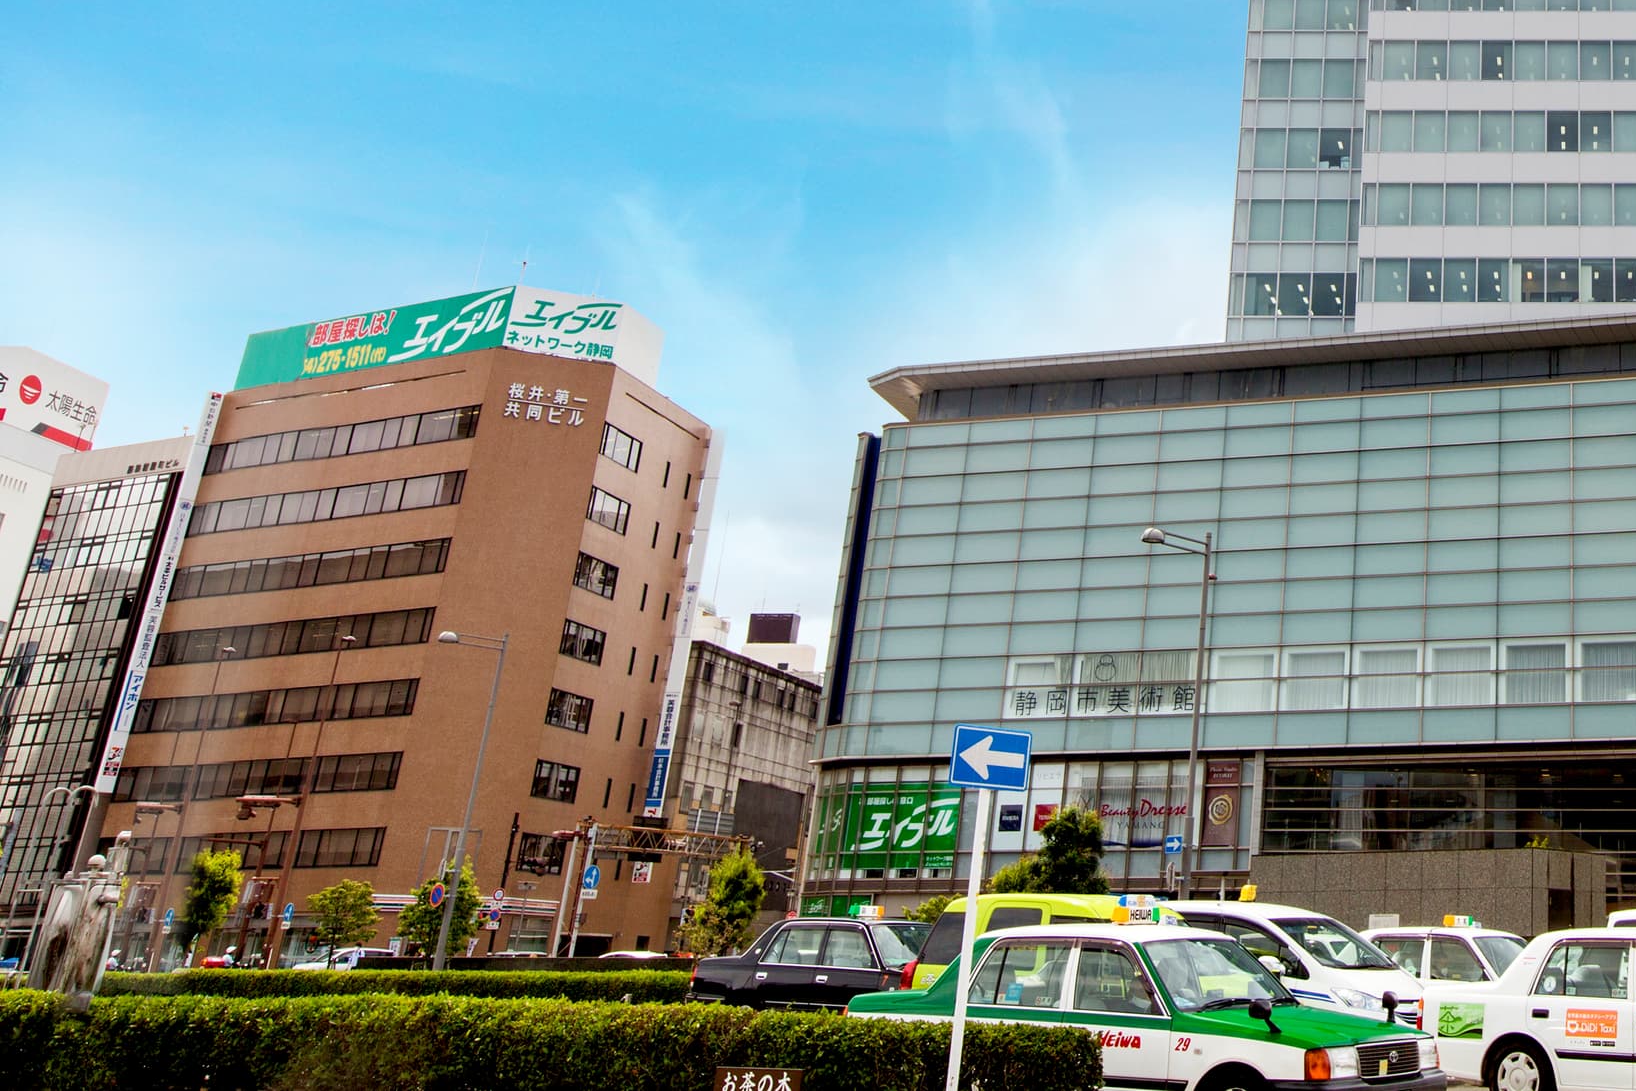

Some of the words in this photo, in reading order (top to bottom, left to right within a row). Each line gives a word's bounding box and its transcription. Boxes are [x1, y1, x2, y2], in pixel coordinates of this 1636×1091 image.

[309, 310, 397, 347] 部屋探しは!
[389, 288, 511, 361] エイブル
[512, 300, 622, 334] エイブル
[507, 330, 614, 359] ネットワーク静岡
[45, 390, 98, 426] 太陽生命
[504, 402, 584, 427] 共同ビル
[125, 675, 144, 710] アイホン
[1015, 685, 1196, 717] 静岡市美術館
[853, 798, 960, 850] エイブル
[1101, 804, 1139, 819] Beauty
[1129, 909, 1152, 920] HEIWA
[1581, 1022, 1598, 1032] DiDi
[1600, 1023, 1616, 1033] Taxi
[1175, 1037, 1191, 1052] 29
[721, 1071, 792, 1091] お茶の木
